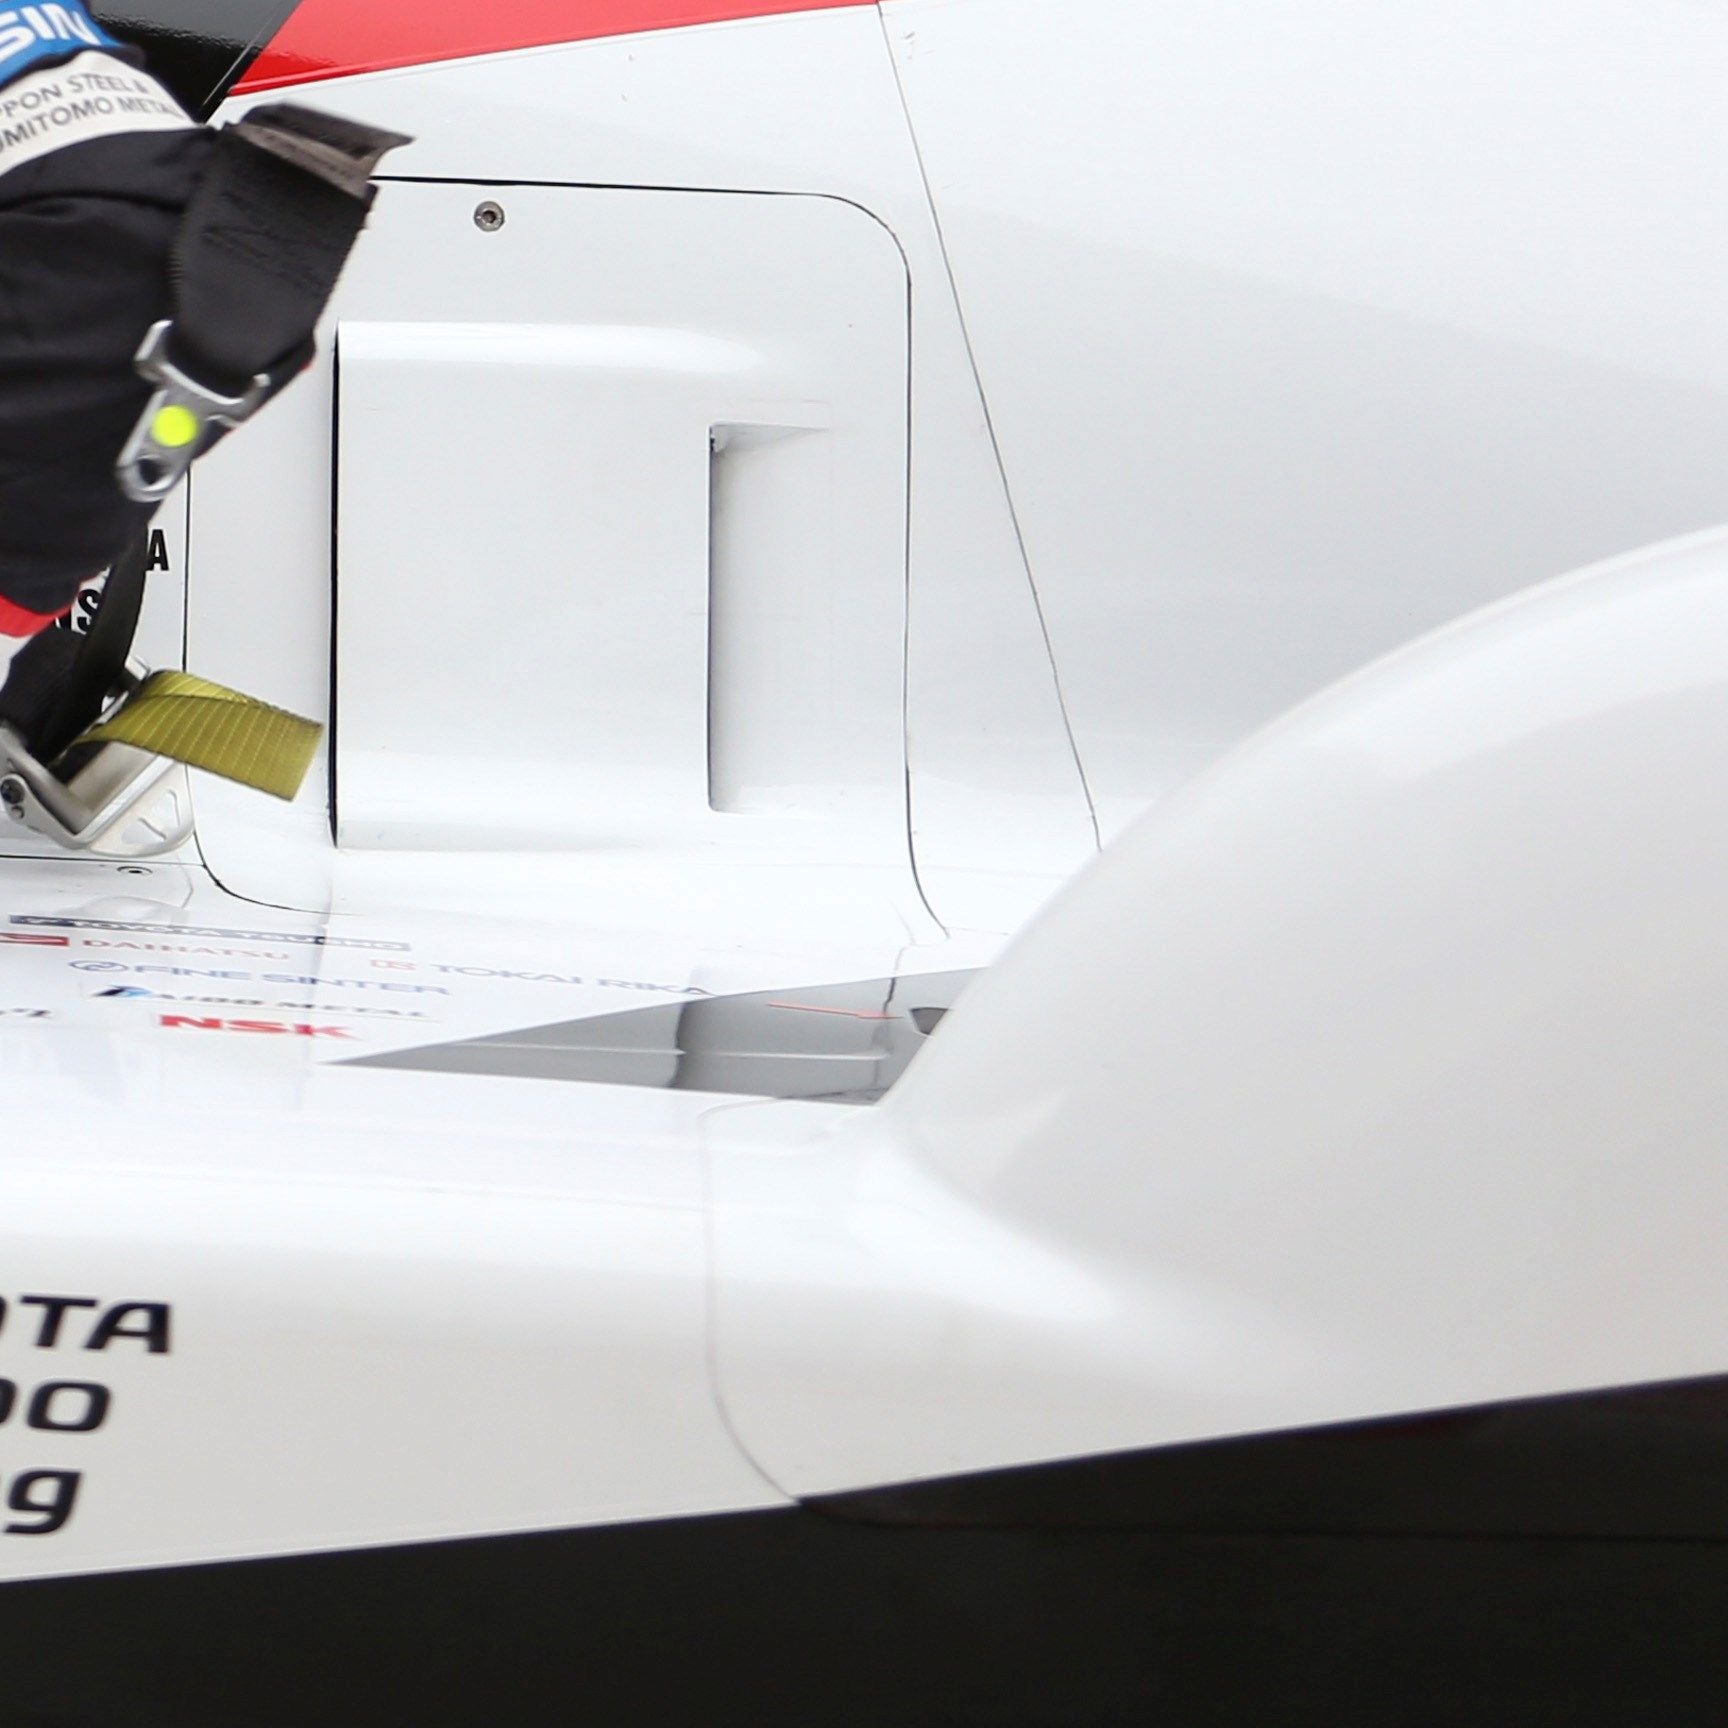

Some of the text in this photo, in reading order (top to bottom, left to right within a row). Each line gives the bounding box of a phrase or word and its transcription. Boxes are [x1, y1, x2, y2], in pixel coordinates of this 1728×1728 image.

[68, 72, 130, 96] STEEL
[118, 97, 185, 119] METAL
[82, 939, 289, 960] DAIHATSU
[133, 964, 451, 996] FINE SINTER
[431, 964, 585, 984] TOKAI
[597, 978, 720, 997] RIKA
[277, 1000, 430, 1018] METAL
[158, 1014, 362, 1041] NSK
